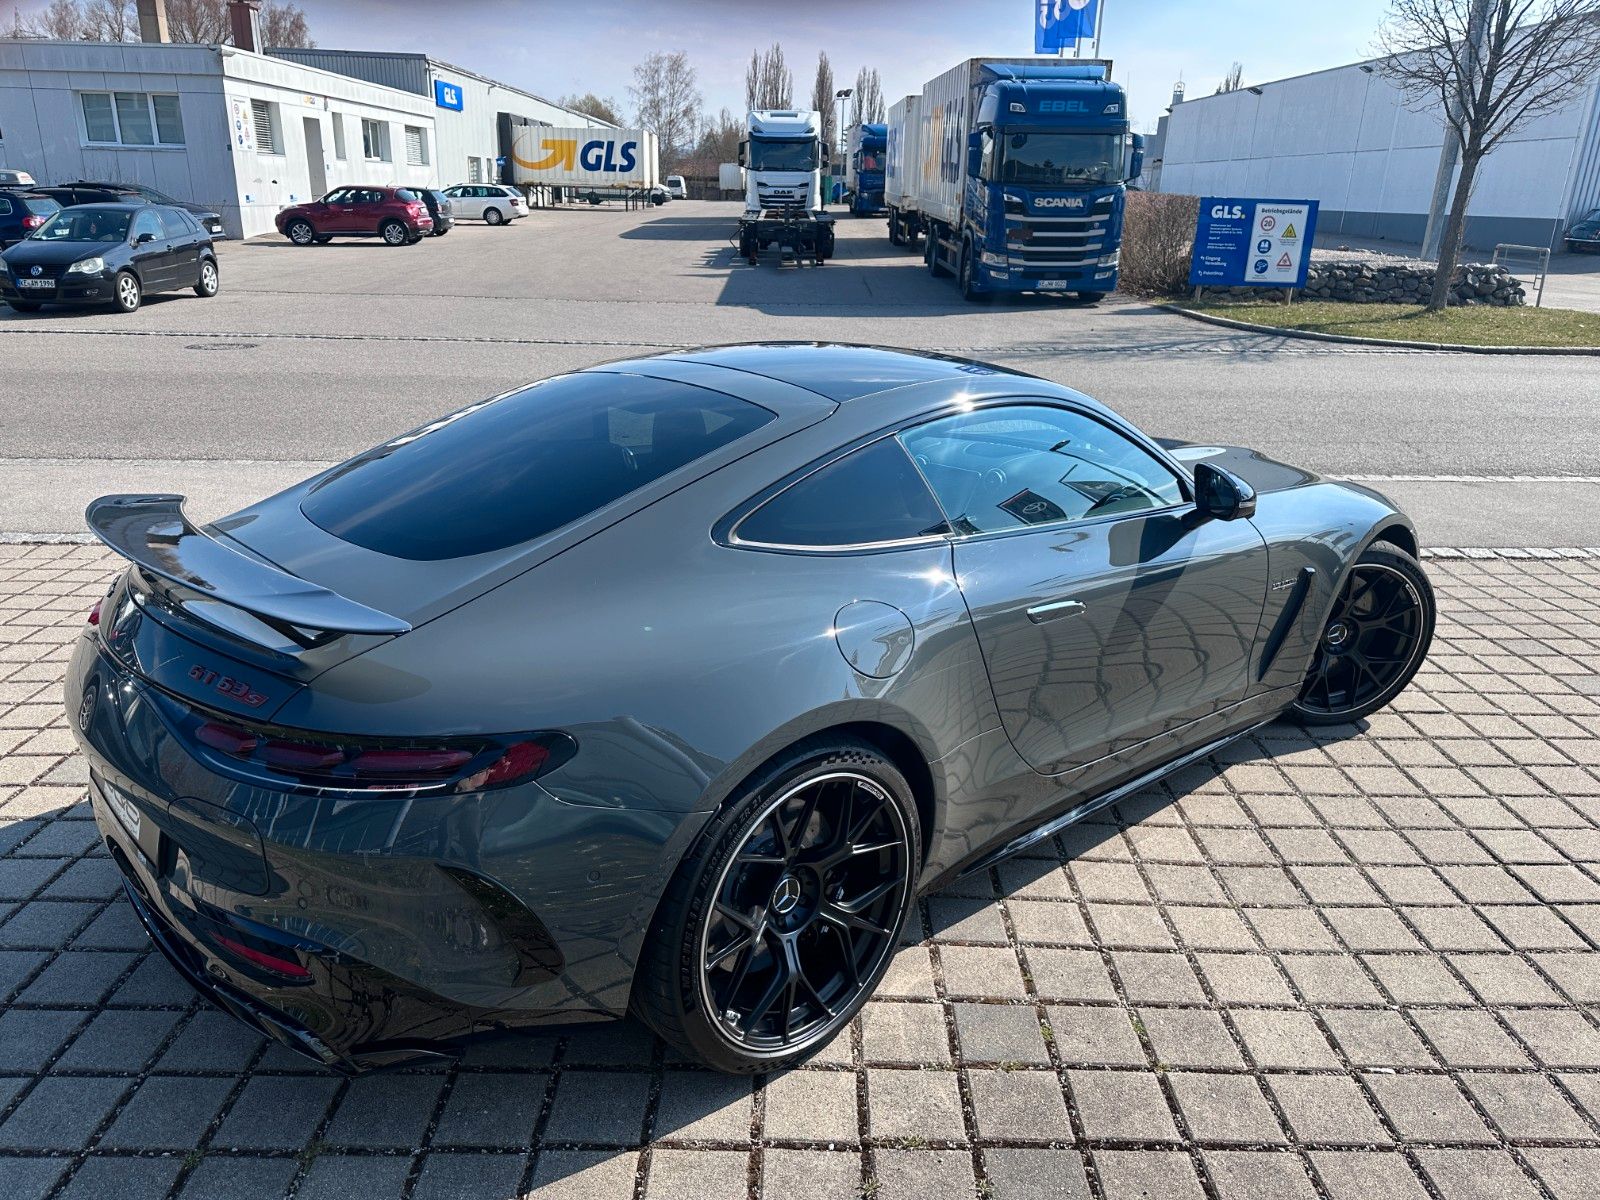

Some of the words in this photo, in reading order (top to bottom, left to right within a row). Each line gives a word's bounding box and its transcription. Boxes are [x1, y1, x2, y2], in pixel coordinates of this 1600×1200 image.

[1039, 100, 1089, 112] EBEL
[580, 140, 637, 173] GLS
[1034, 198, 1084, 208] SCANIA
